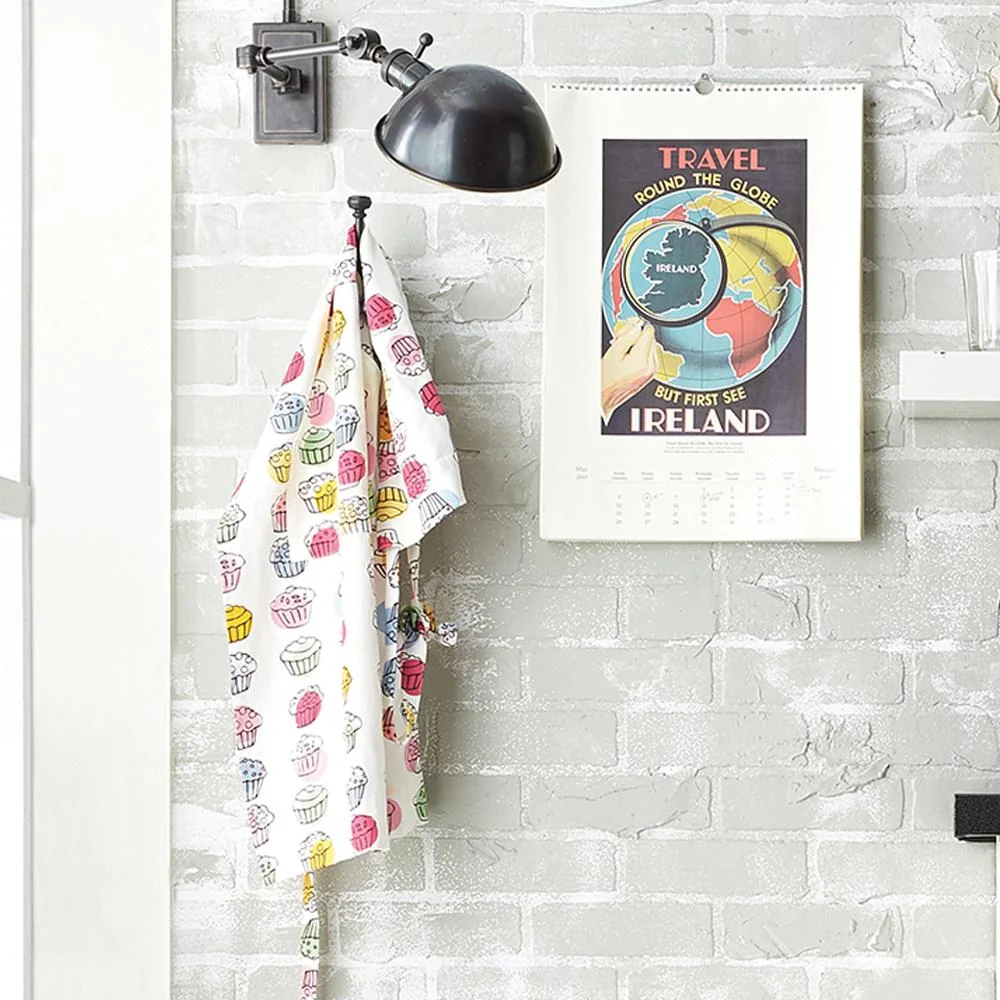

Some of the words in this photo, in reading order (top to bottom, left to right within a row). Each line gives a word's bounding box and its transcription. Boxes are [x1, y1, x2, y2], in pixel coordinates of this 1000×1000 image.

[658, 147, 766, 171] TRAVEL
[633, 175, 686, 205] ROUND
[692, 173, 722, 186] THE
[730, 178, 779, 210] GLOBE
[656, 264, 698, 274] IRELAND
[655, 385, 679, 403] BUT
[684, 393, 719, 407] FIRST
[722, 386, 746, 403] SEE
[630, 407, 771, 433] IRELAND
